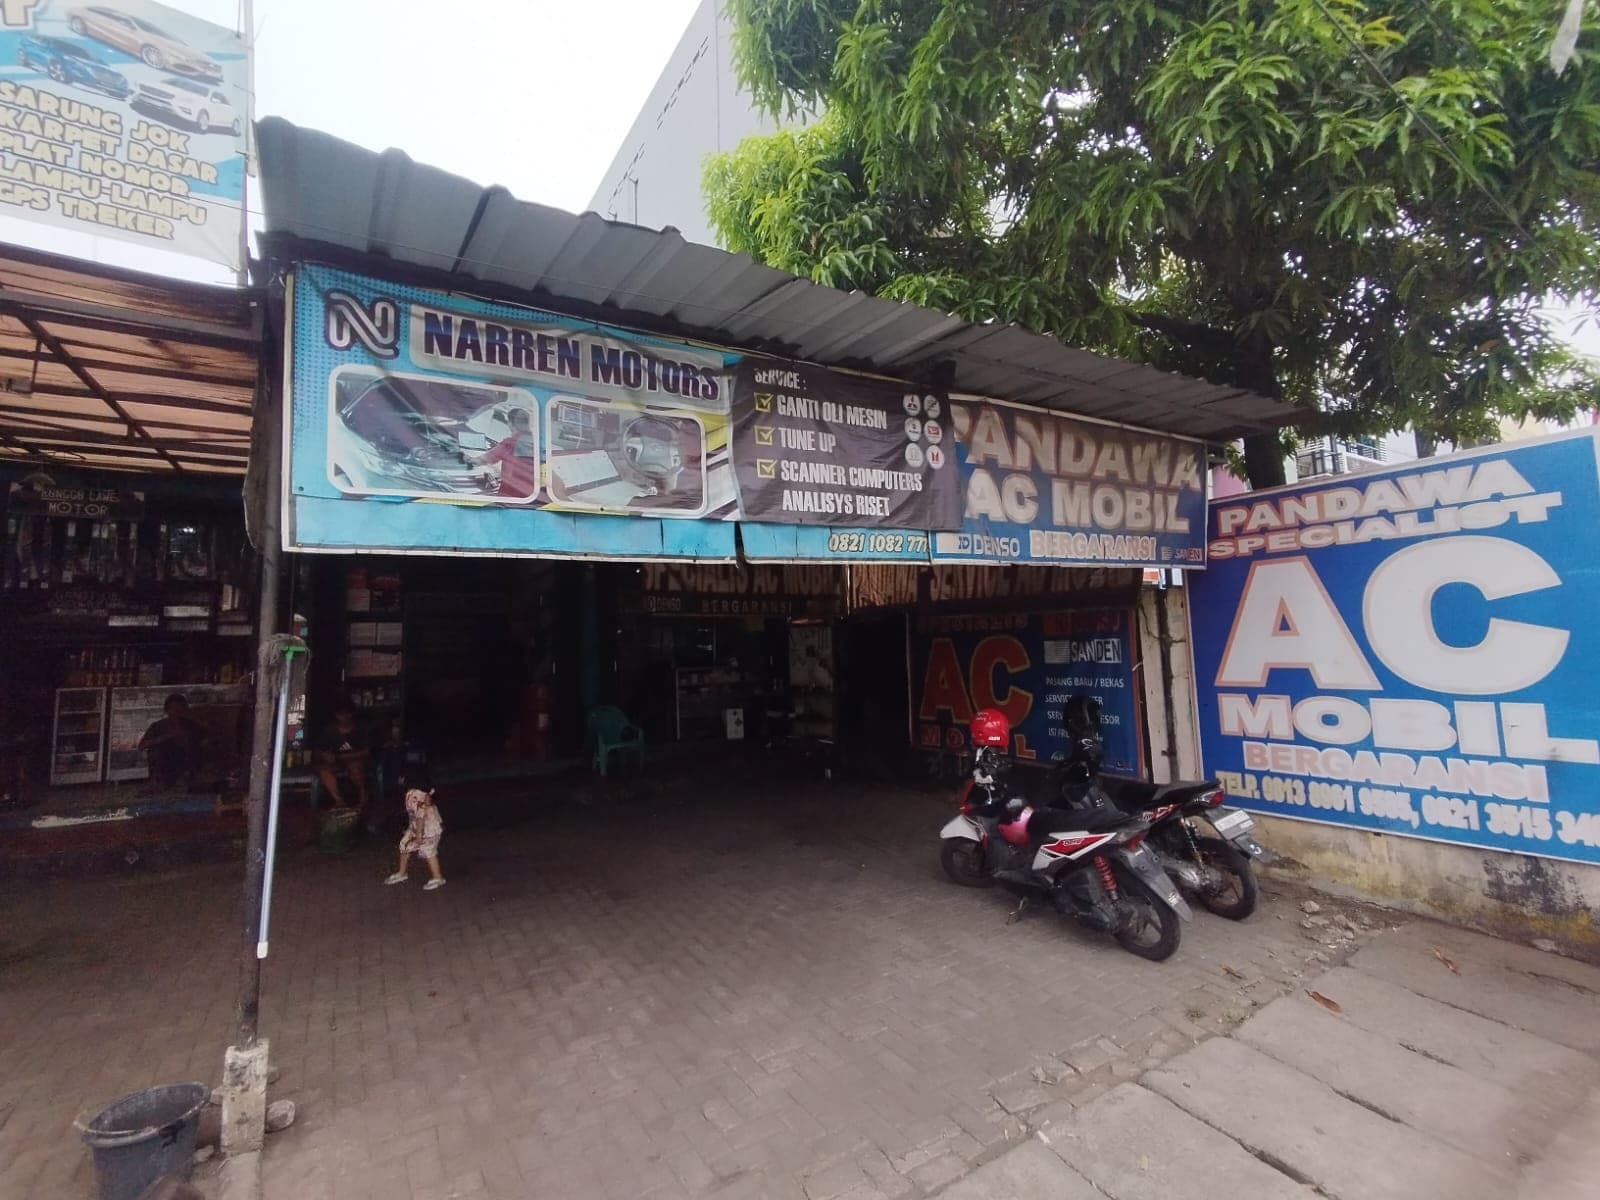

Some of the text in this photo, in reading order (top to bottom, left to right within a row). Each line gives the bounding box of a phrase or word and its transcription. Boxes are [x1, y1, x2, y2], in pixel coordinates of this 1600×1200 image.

[0, 80, 190, 154] SARUNG JOK
[0, 104, 217, 185] KARPET DASAR
[80, 150, 190, 199] NOMOR
[57, 192, 175, 240] TREKER
[424, 311, 720, 401] NARREN MOTORS
[777, 394, 887, 430] GANTI OLI MESIN
[778, 427, 837, 453] TUNE UP
[780, 459, 923, 492] SCANNER COMPUTERS
[1220, 458, 1536, 537] PANDAWA
[782, 488, 890, 517] ANALISYS RISET
[965, 467, 1190, 534] AC MOBIL
[828, 533, 865, 552] 0821
[869, 534, 902, 553] 1082
[974, 537, 1020, 557] DENSO
[1029, 529, 1156, 561] BERGARANSI
[1207, 491, 1563, 560] SPECIALIST
[1214, 535, 1571, 695] AC
[1071, 638, 1122, 664] SANDEN
[919, 635, 1034, 729] AC
[1100, 678, 1125, 688] BEKAS
[920, 725, 1037, 760] MOL
[1217, 692, 1600, 764] MOBIL
[1243, 740, 1551, 803] BERGARANSI
